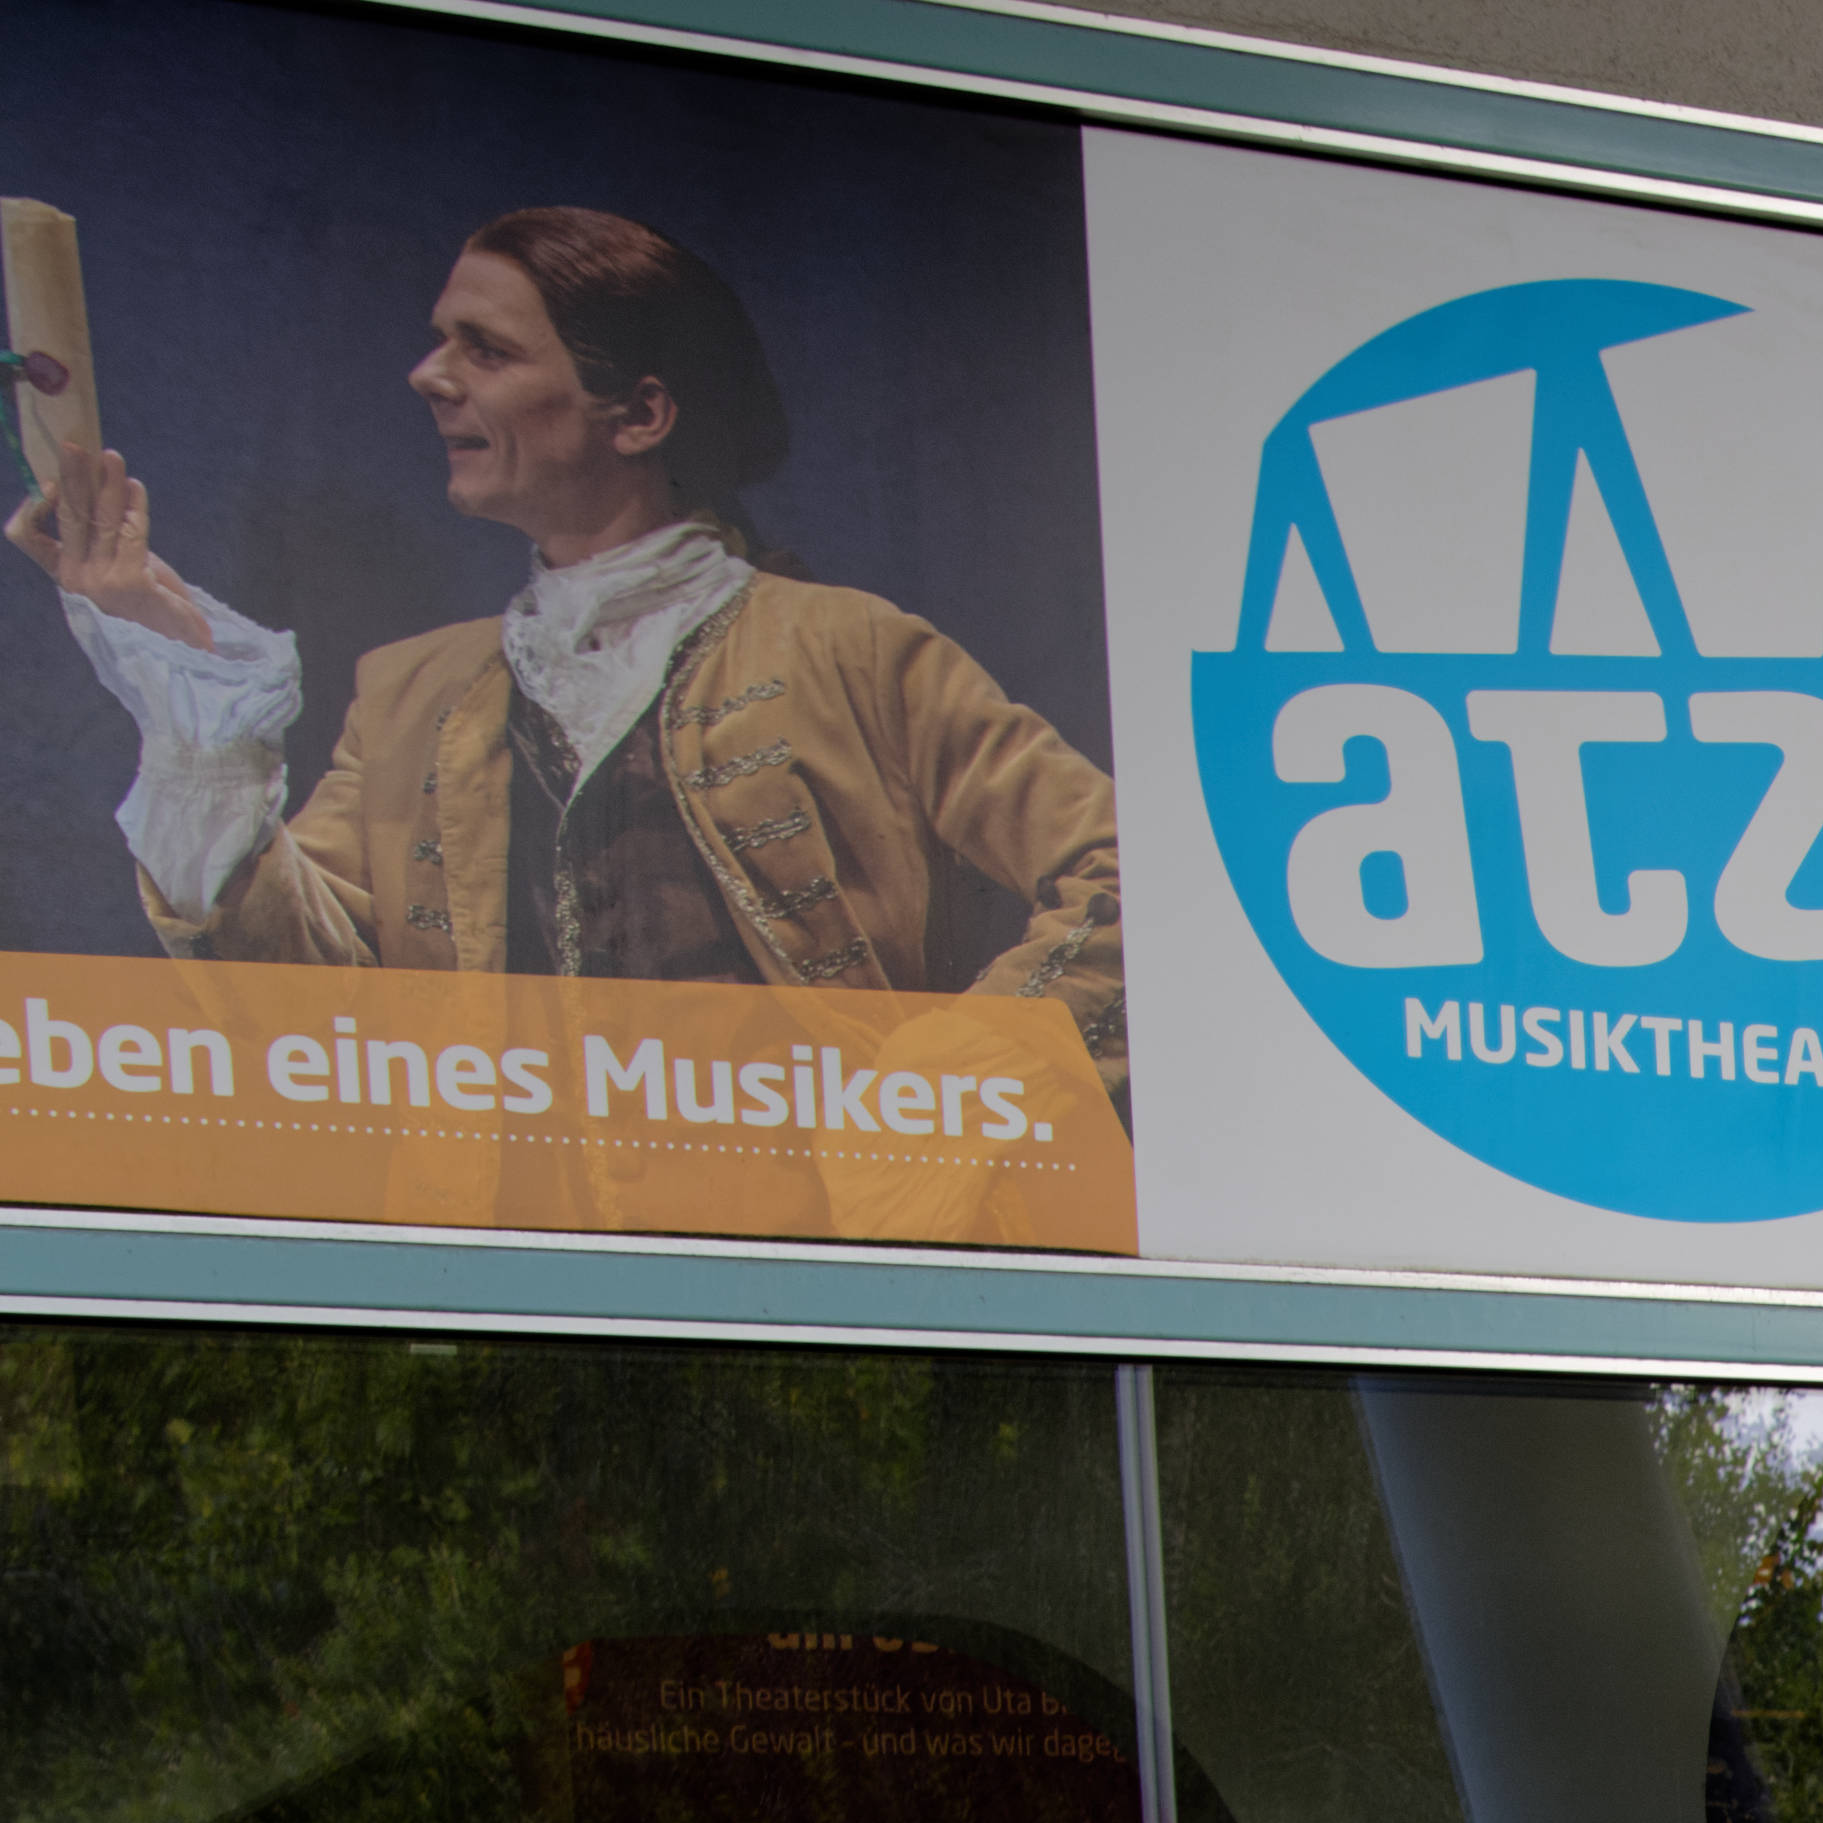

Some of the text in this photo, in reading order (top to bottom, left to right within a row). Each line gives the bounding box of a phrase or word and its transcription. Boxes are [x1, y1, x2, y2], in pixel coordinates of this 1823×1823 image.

[265, 1015, 553, 1114] eines
[582, 1034, 1053, 1142] Musikers.
[659, 1680, 703, 1710] Ein
[718, 1679, 912, 1715] Theaterstück
[920, 1689, 974, 1716] von
[983, 1685, 1033, 1715] Uta
[575, 1721, 718, 1755] häusliche
[730, 1723, 834, 1757] Gewalt
[862, 1726, 917, 1758] und
[926, 1731, 985, 1758] was
[992, 1727, 1035, 1758] wir
